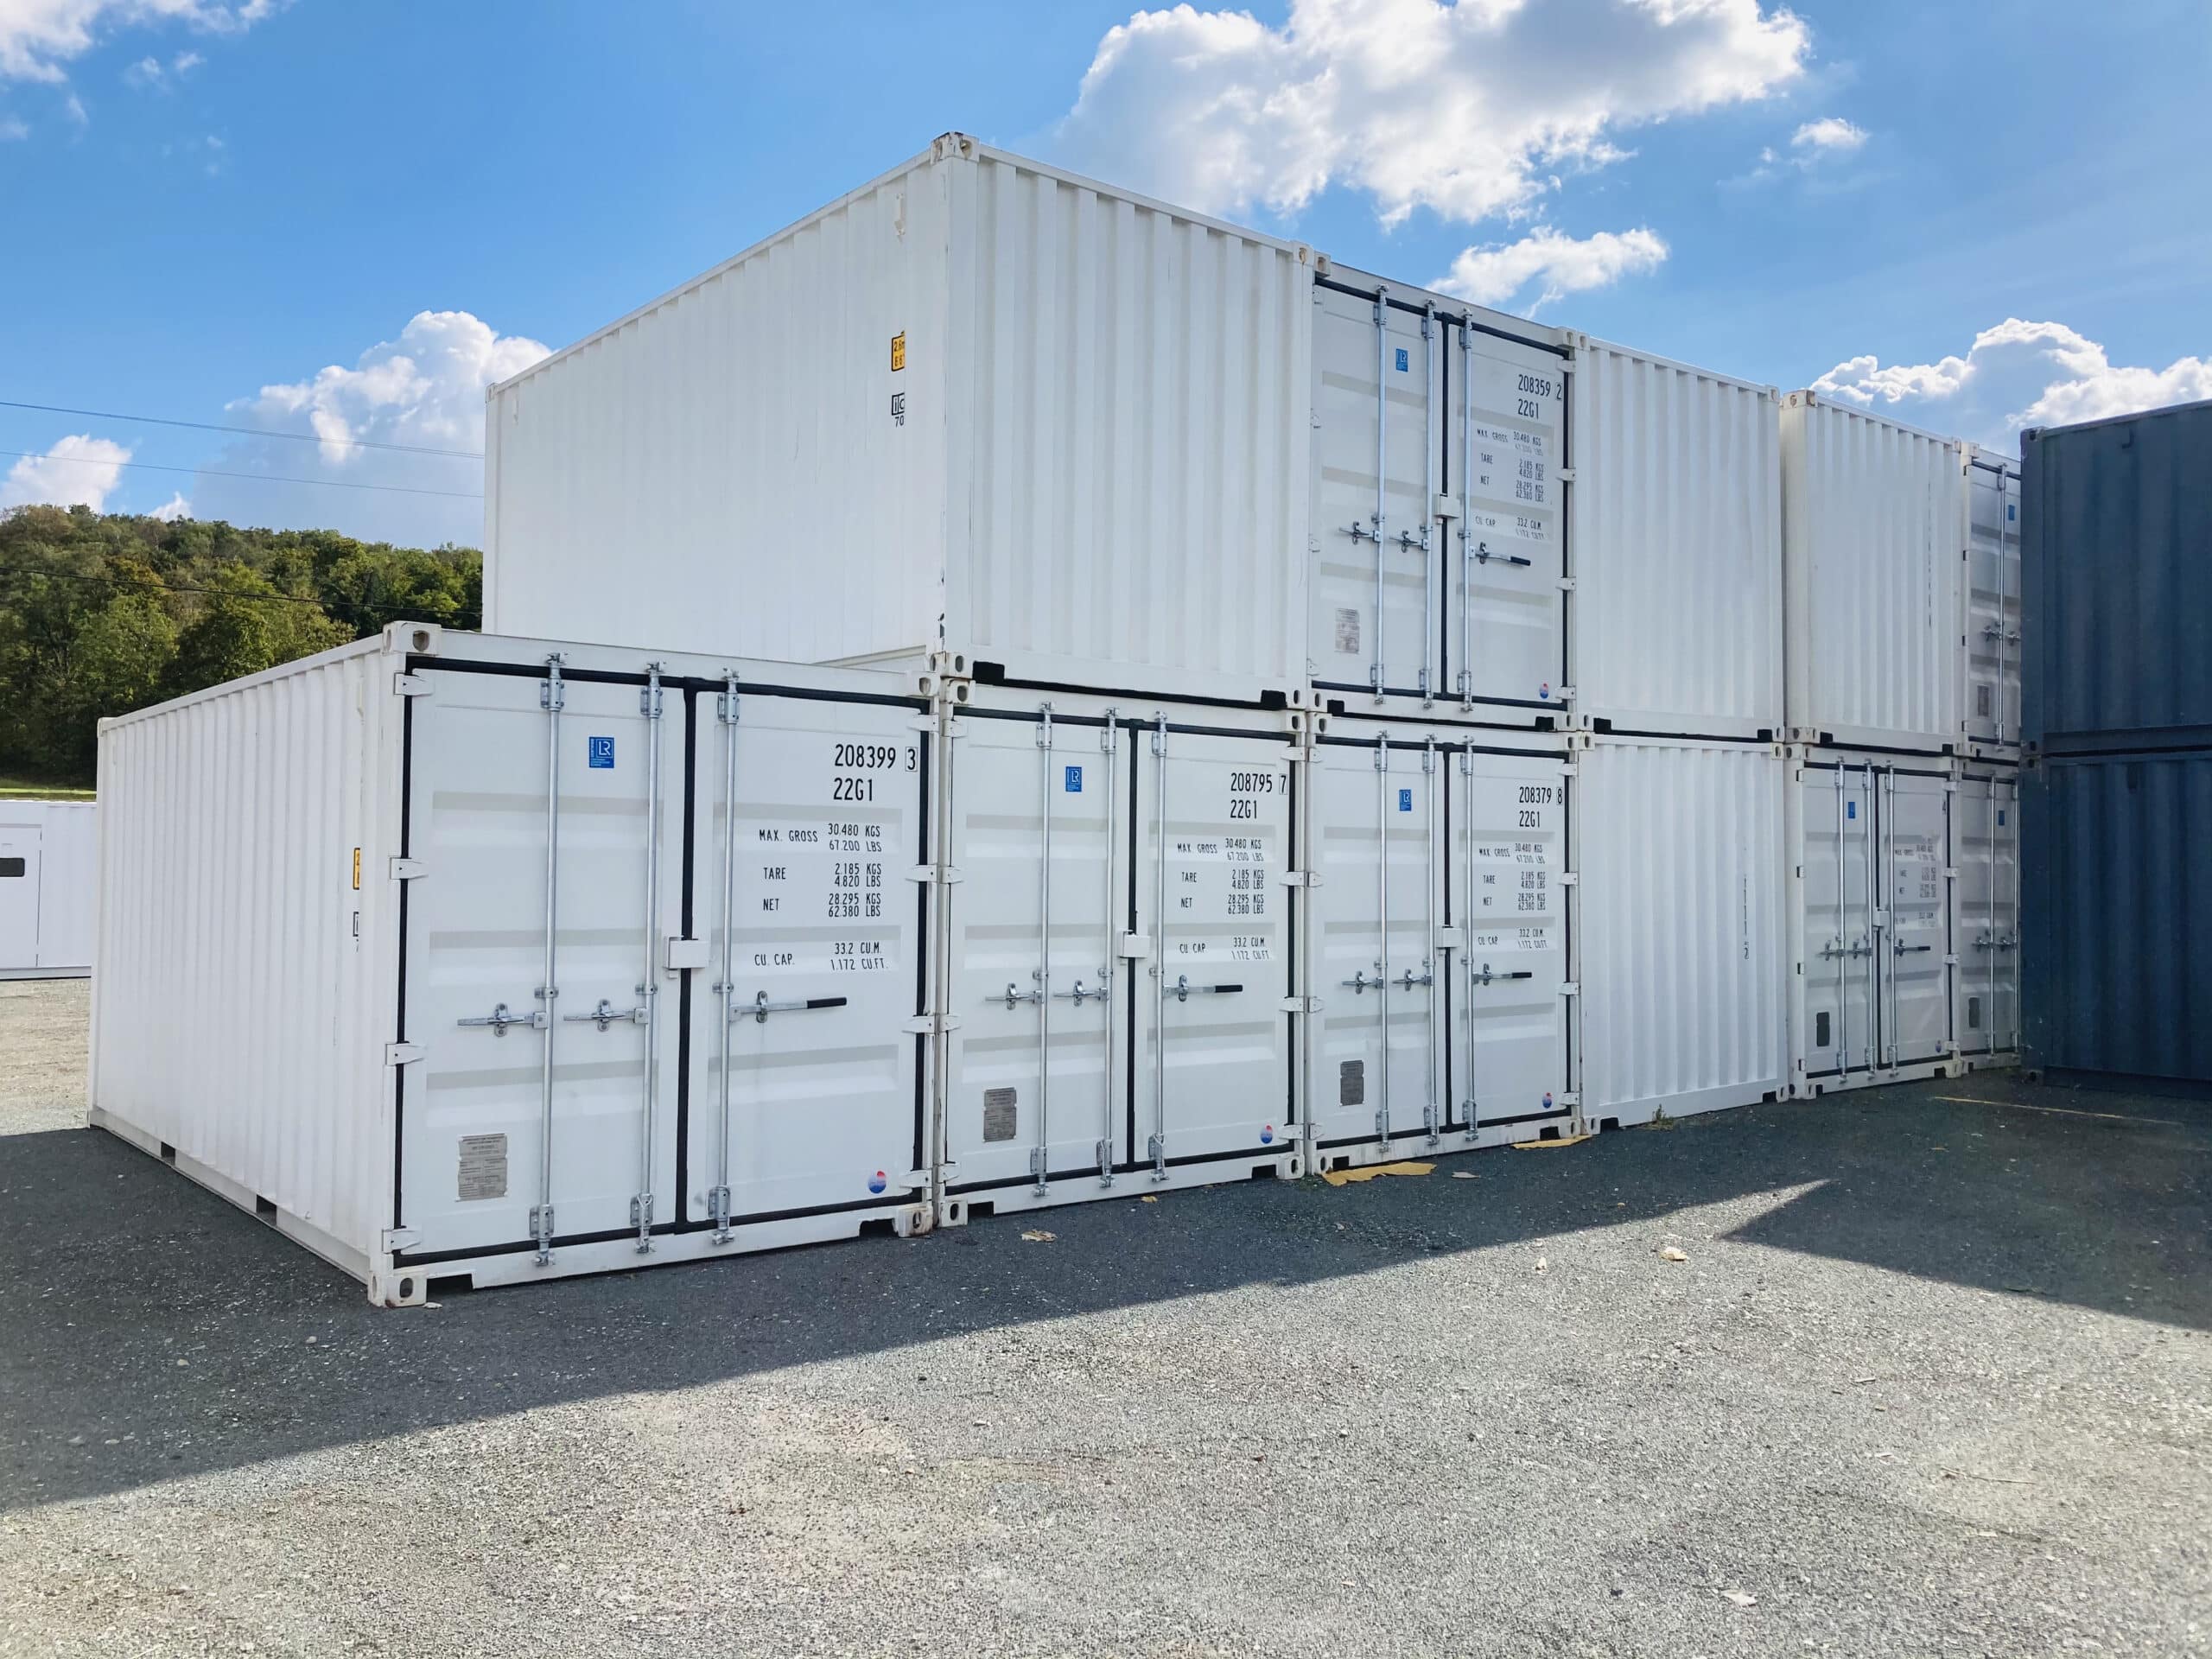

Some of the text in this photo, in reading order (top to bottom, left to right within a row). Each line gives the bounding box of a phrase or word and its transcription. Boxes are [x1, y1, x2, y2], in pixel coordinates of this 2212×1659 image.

[1518, 374, 1562, 400] 208359 2
[1518, 398, 1539, 419] 22G1
[895, 415, 904, 428] 70
[1481, 452, 1493, 464] TARE
[1480, 475, 1489, 486] NET
[598, 741, 610, 756] LR
[835, 744, 916, 771] 208399 3
[833, 777, 872, 801] 22G1
[1230, 772, 1287, 794] 208795 7
[1519, 787, 1562, 804] 208379 8
[1230, 799, 1257, 819] 22G1
[1519, 810, 1540, 828] 22G1
[788, 830, 818, 842] GROSS
[865, 825, 880, 837] KGS
[865, 841, 882, 852] LBS
[1197, 843, 1218, 854] GROSS
[1250, 839, 1262, 849] KGS
[1252, 853, 1264, 861] LBS
[763, 867, 787, 880] TARE
[835, 863, 882, 875] 2.185 KGS
[1253, 869, 1264, 879] KGS
[866, 875, 881, 887] LBS
[1182, 871, 1197, 883] TARE
[1483, 875, 1496, 884] TARE
[1253, 880, 1264, 889] LBS
[1537, 880, 1546, 889] LBS
[763, 898, 779, 911] NET
[829, 893, 881, 905] 28.295 KGS
[1181, 897, 1193, 908] NET
[1253, 894, 1264, 904] KGS
[1483, 896, 1492, 906] NET
[828, 905, 881, 917] 62.380 LBS
[1253, 905, 1264, 914] LBS
[834, 942, 853, 955] 33.2
